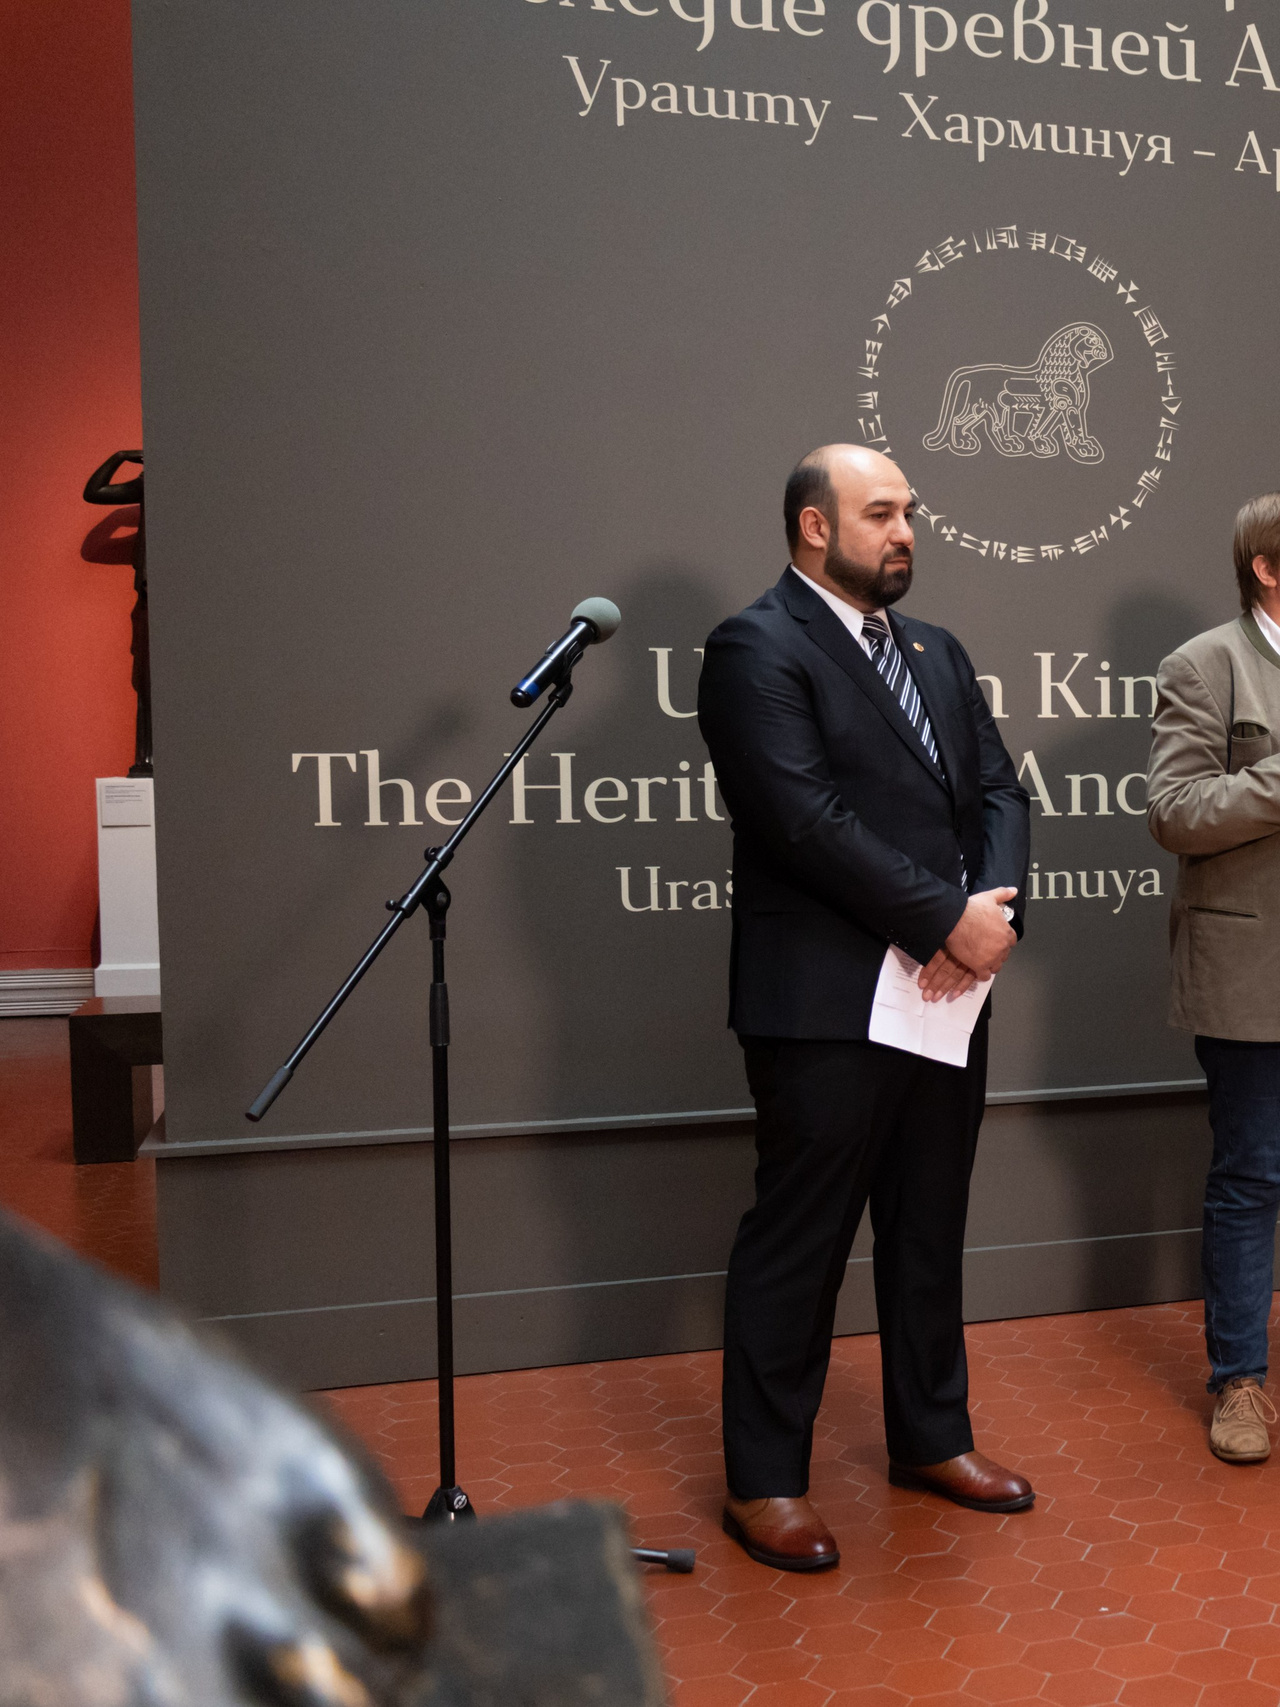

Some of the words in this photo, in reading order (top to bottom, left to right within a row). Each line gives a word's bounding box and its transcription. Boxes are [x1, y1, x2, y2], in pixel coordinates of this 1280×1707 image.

[856, 0, 1202, 83] древней
[562, 55, 832, 146] Урашту
[898, 92, 1175, 177] Харминуя
[291, 749, 472, 827] The
[1026, 862, 1165, 914] inuya
